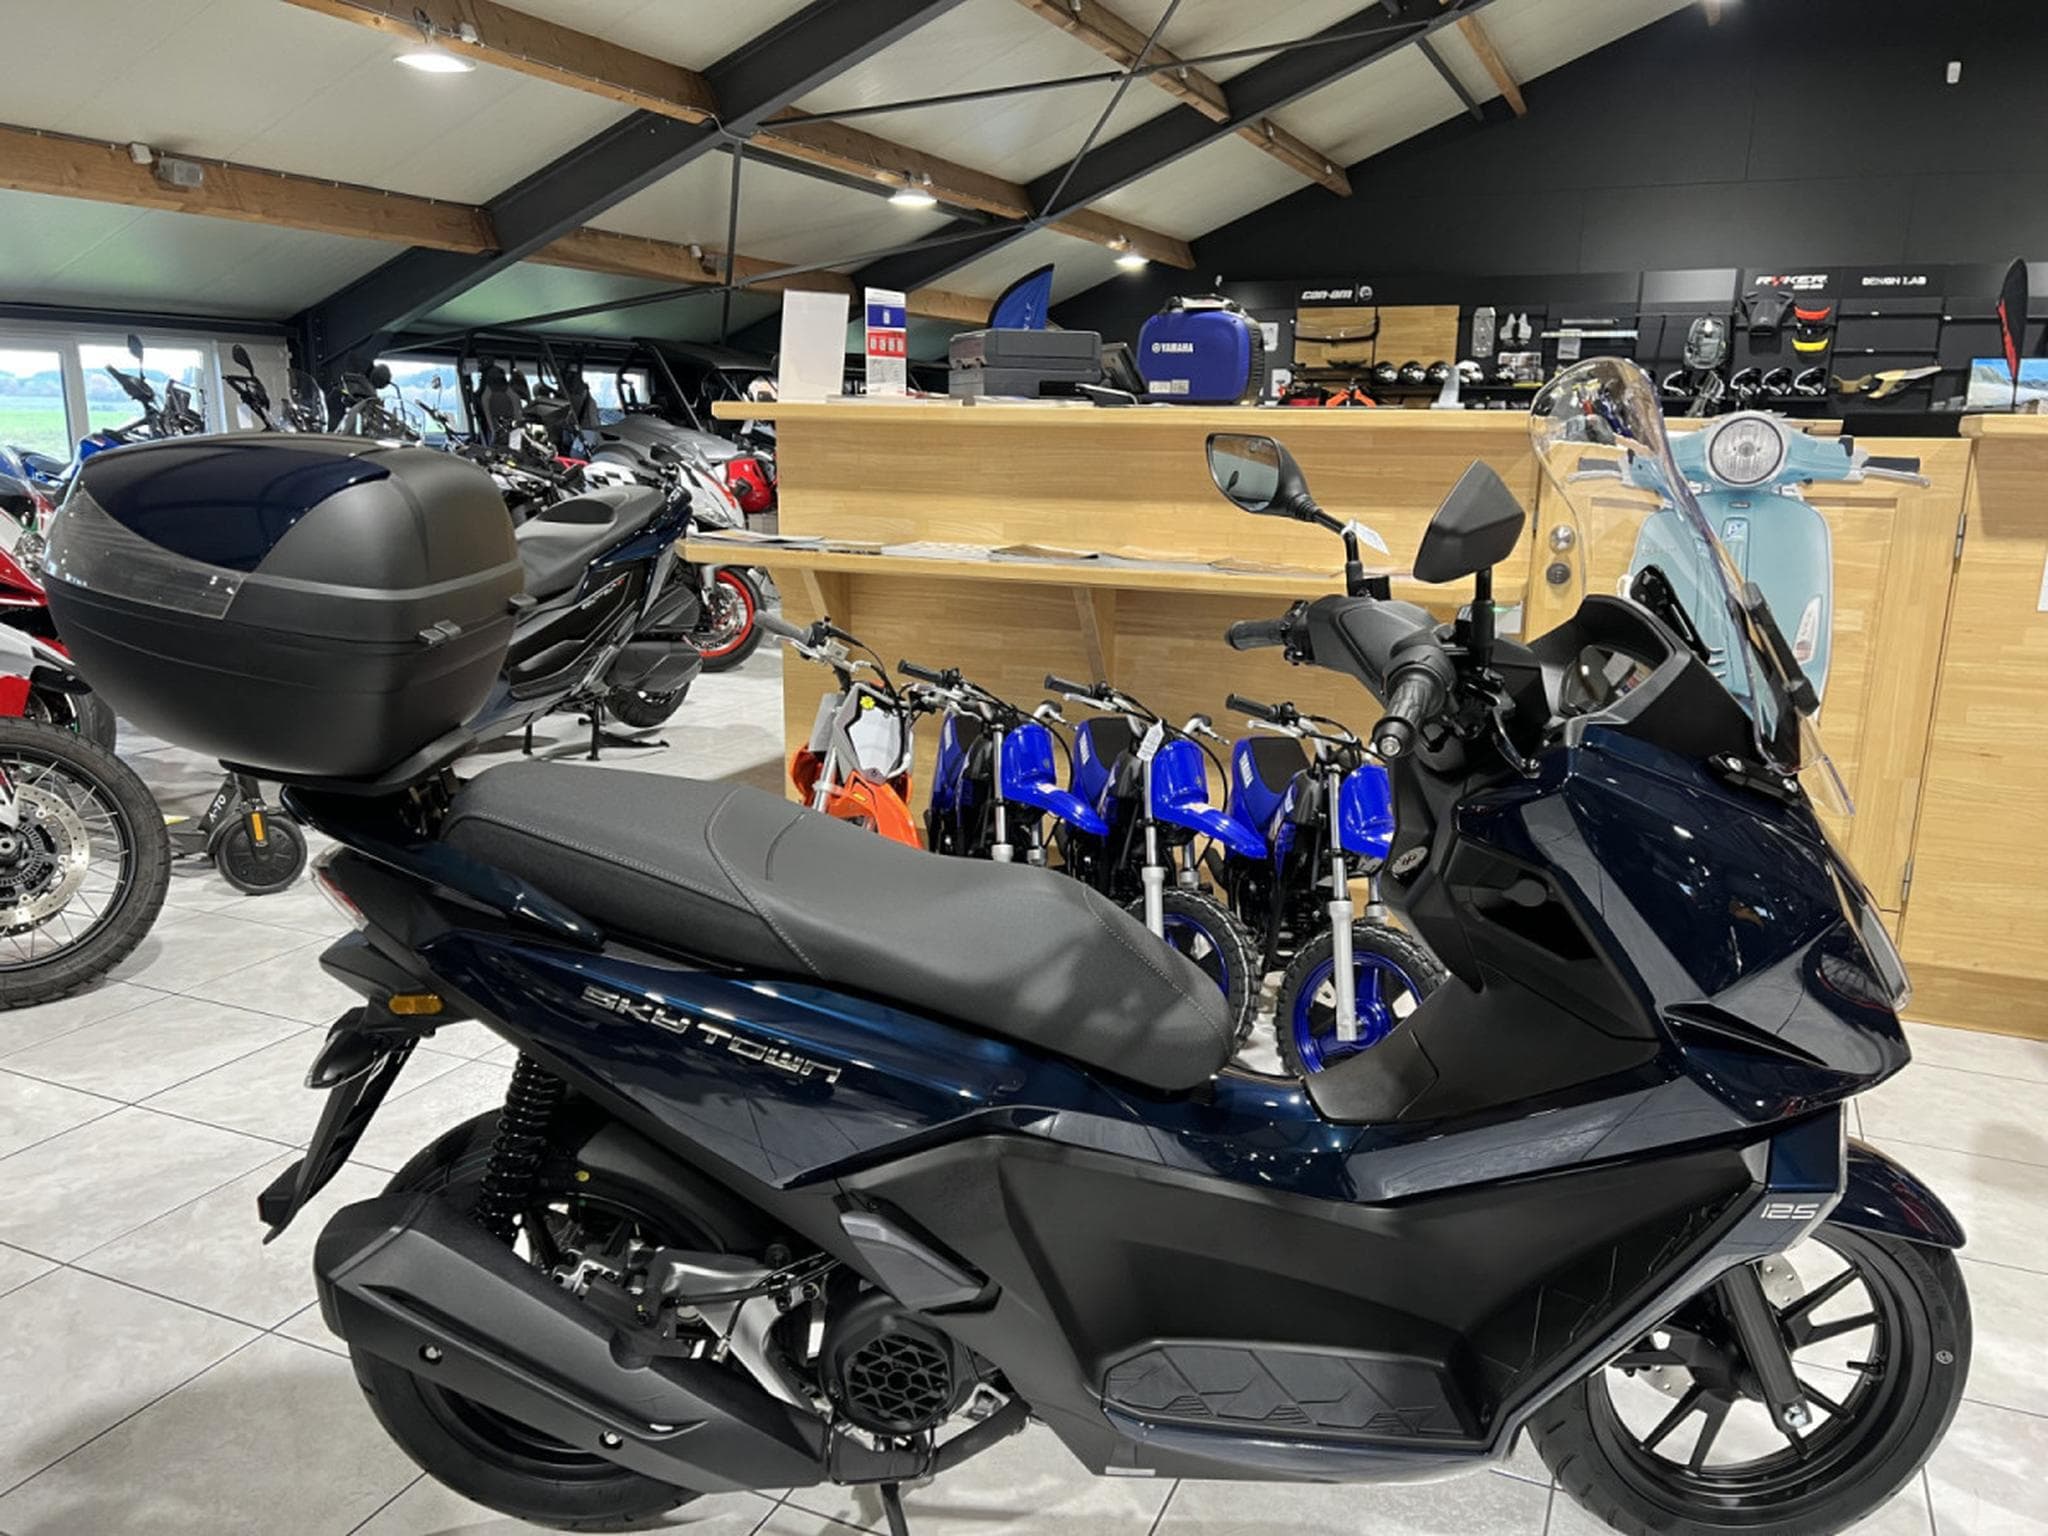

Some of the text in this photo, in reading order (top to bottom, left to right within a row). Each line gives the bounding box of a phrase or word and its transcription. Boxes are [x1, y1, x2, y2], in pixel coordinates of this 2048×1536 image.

[1161, 342, 1194, 353] YAMAHA
[581, 985, 691, 1034] SKY
[1760, 1202, 1820, 1220] 125
